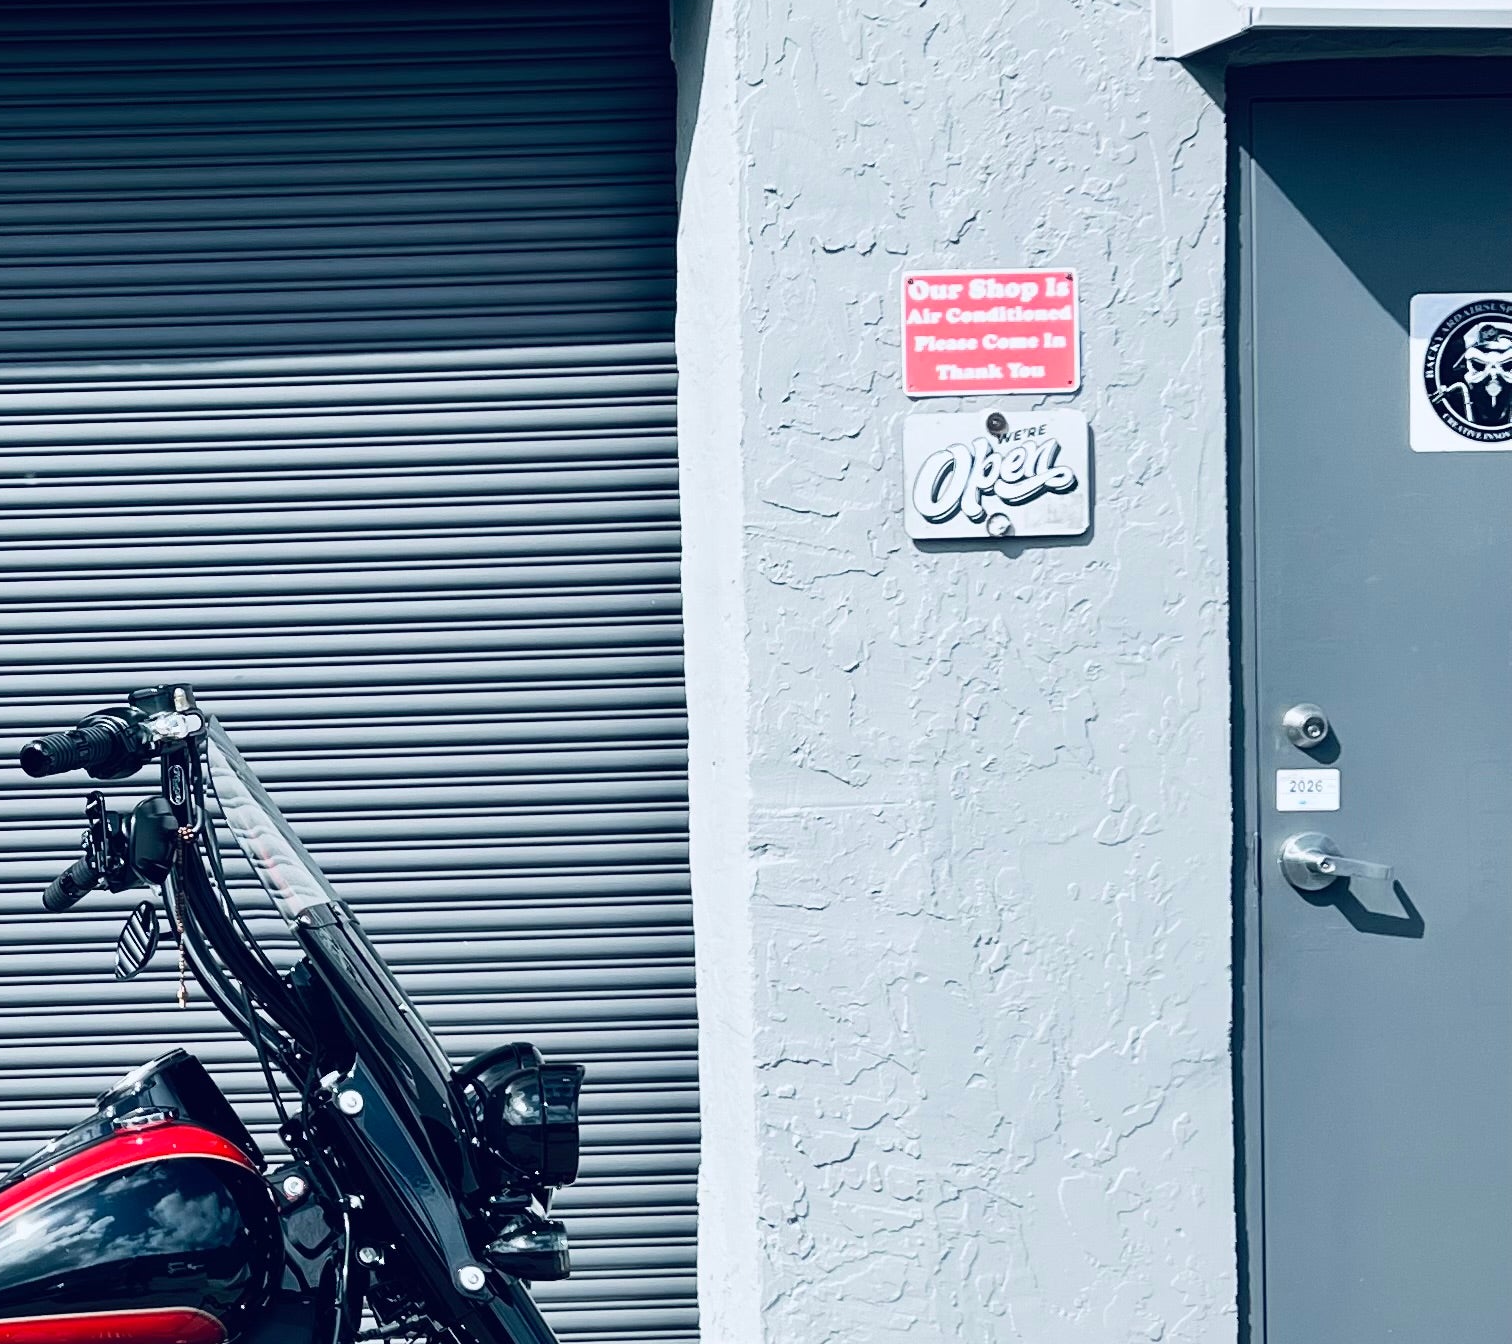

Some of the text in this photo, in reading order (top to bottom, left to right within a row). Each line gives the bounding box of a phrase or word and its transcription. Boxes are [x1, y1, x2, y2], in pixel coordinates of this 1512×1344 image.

[908, 277, 1071, 301] Our Shop Is
[906, 306, 1072, 325] Air Conditioned
[914, 333, 1067, 352] Please Come In
[936, 362, 1045, 381] Thank You
[998, 424, 1048, 444] WE'RE
[912, 436, 1080, 524] Open
[1290, 780, 1324, 793] 2026
